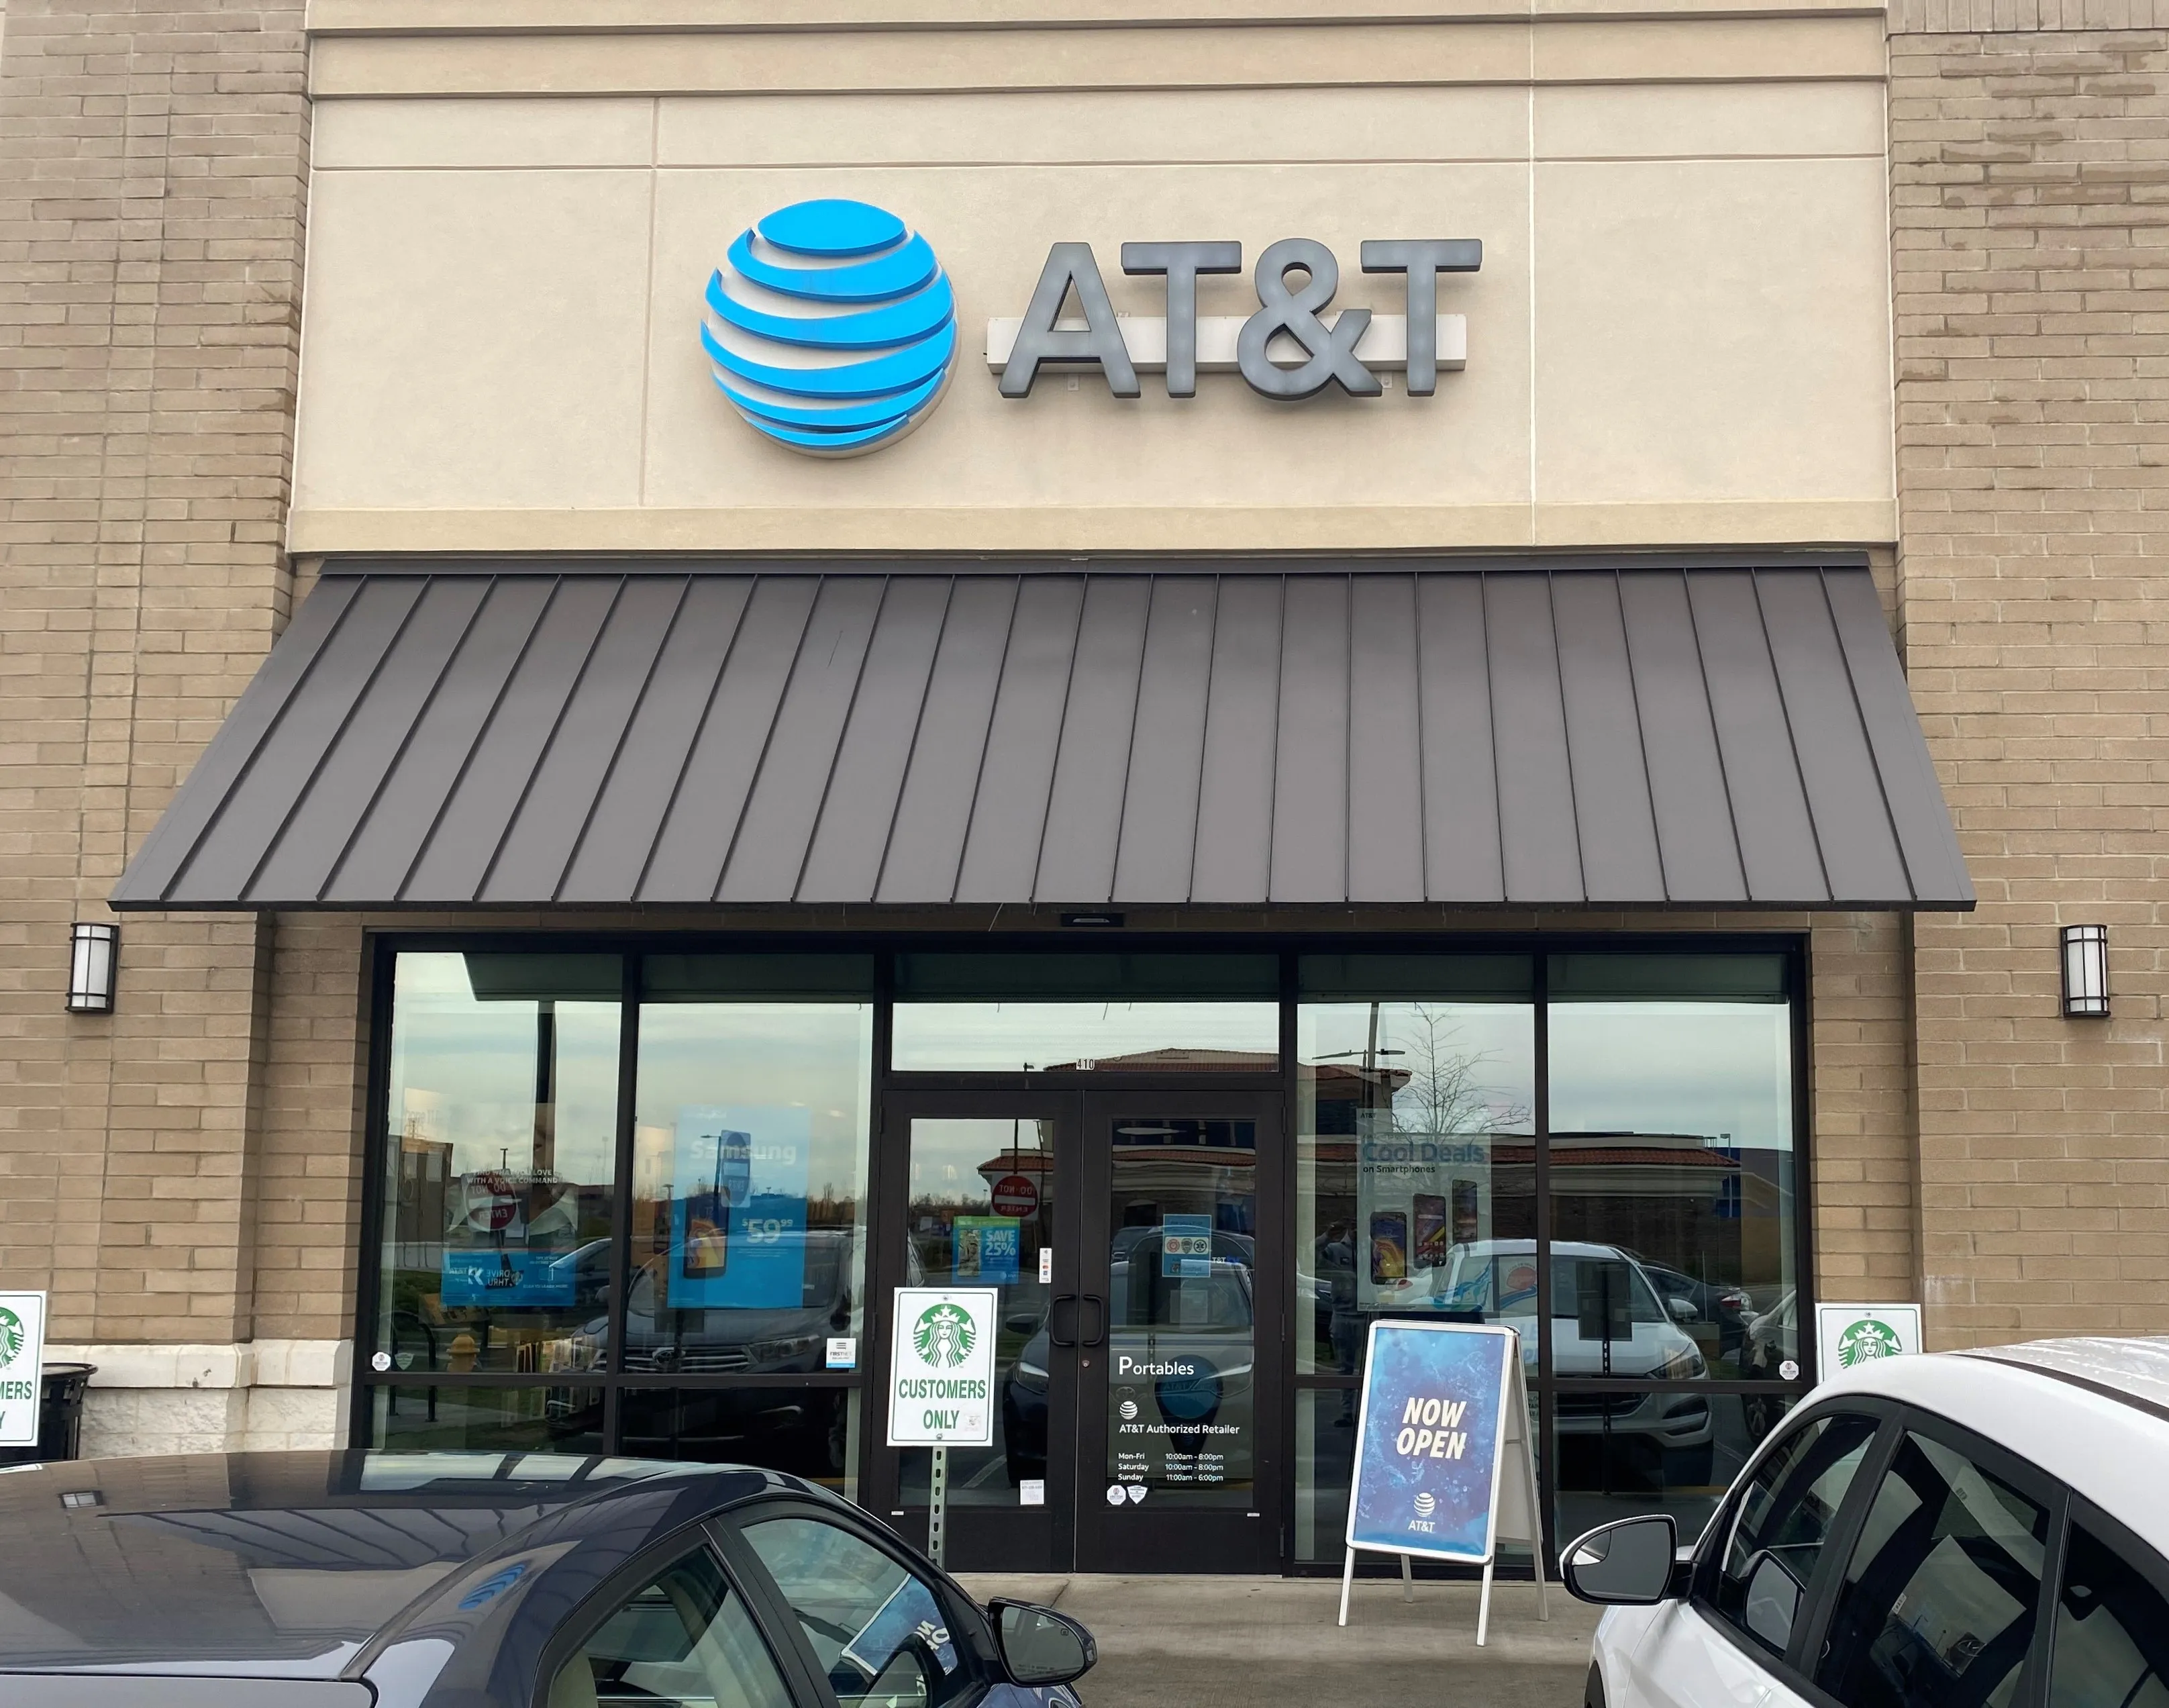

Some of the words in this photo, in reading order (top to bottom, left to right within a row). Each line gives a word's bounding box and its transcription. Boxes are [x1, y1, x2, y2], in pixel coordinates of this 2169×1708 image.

[999, 238, 1482, 401] AT&T
[1077, 1058, 1094, 1069] 410
[690, 1140, 797, 1164] Samsung
[1363, 1142, 1413, 1162] Cool
[1421, 1142, 1484, 1162] Deals
[1376, 1165, 1435, 1174] Smartphones
[986, 1229, 1015, 1242] SAVE
[985, 1242, 1016, 1256] 25%
[1119, 1356, 1194, 1375] Portables
[899, 1379, 986, 1399] CUSTOMERS
[923, 1409, 960, 1429] ONLY
[1402, 1397, 1467, 1428] NOW
[1119, 1424, 1145, 1434] AT&T
[1146, 1424, 1200, 1434] Authorized
[1203, 1424, 1240, 1434] Retailer
[1396, 1428, 1467, 1460] OPEN
[1199, 1454, 1224, 1462] 8:00pm
[1118, 1463, 1149, 1472] Saturday
[1199, 1464, 1224, 1472] 8:00pm
[1118, 1474, 1144, 1482] Sunday
[1408, 1520, 1435, 1533] AT&T
